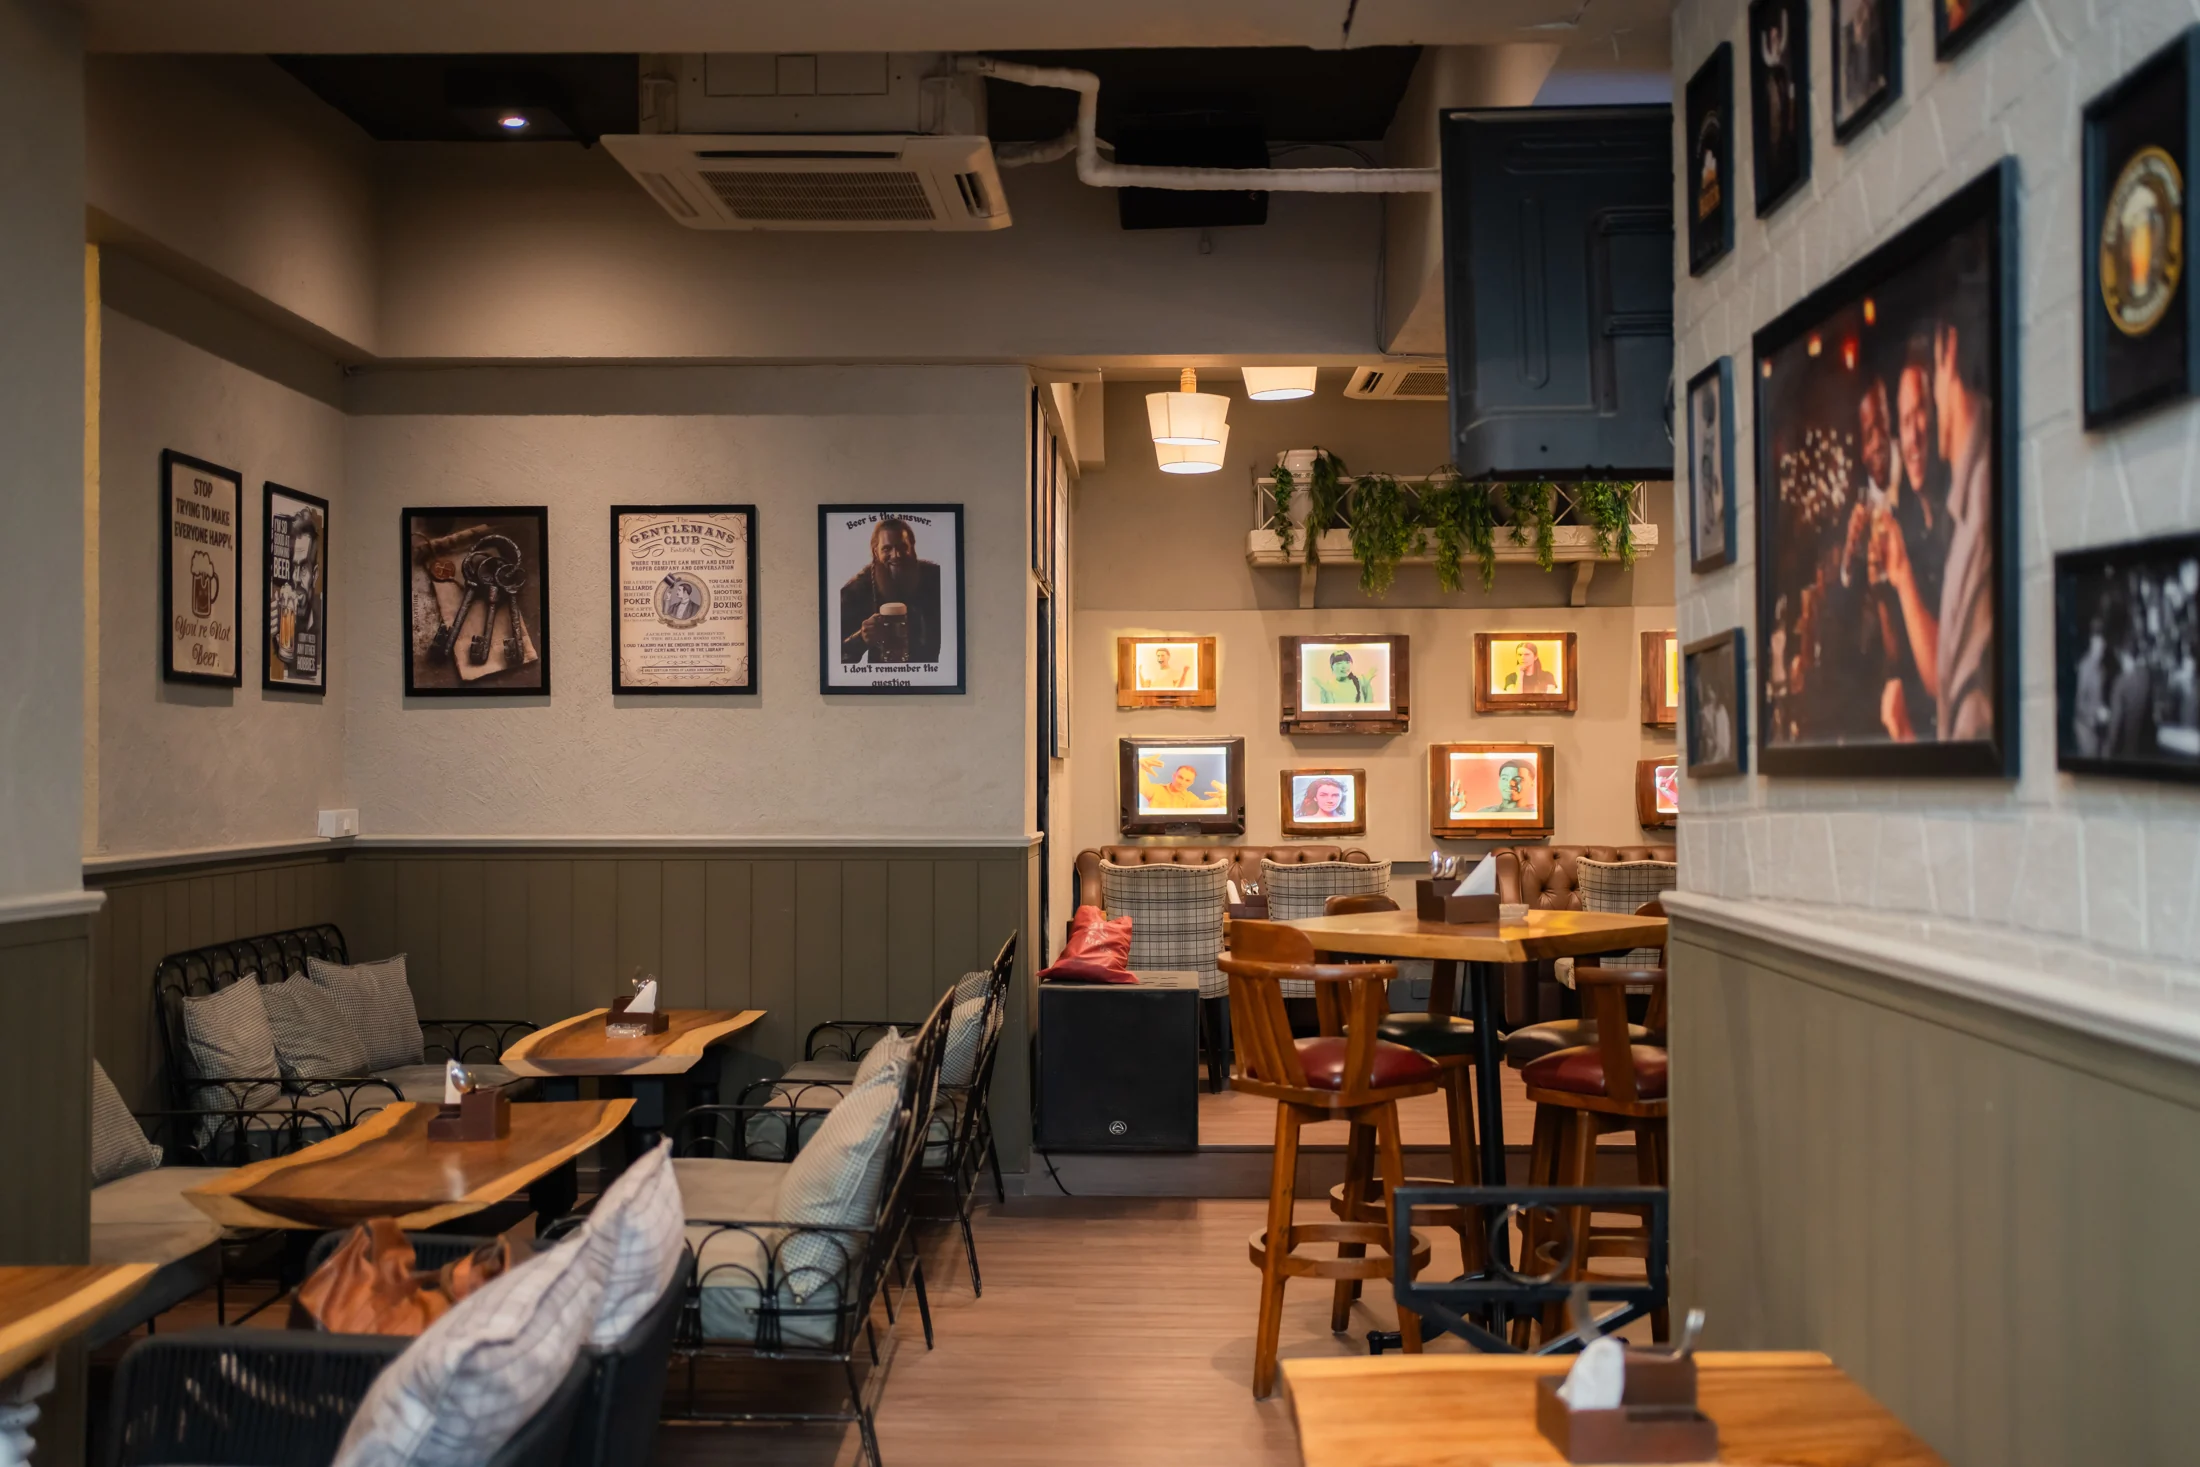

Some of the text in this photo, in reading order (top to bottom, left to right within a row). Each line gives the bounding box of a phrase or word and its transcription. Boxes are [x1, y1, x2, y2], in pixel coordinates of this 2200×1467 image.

[193, 478, 213, 498] STOP
[176, 497, 230, 526] TRYING TO MAKE
[846, 512, 932, 530] Beer is the answer.
[174, 521, 232, 551] EVERYONE HAPPY,
[630, 524, 735, 544] GENTLEMANS
[664, 536, 700, 545] CLUB
[274, 557, 290, 580] BEER
[175, 615, 231, 641] You're Not
[844, 664, 938, 673] I don't remember the
